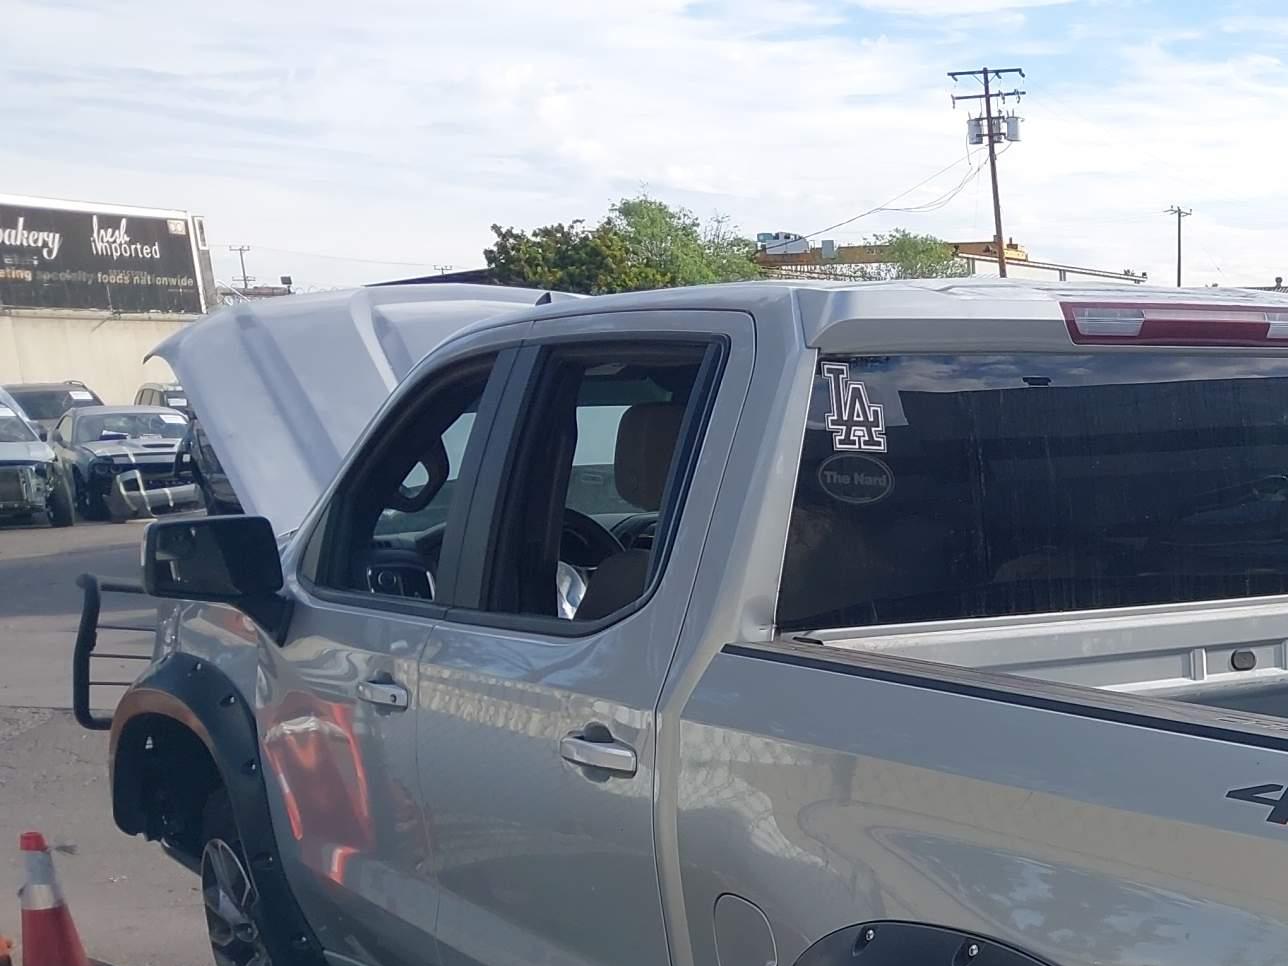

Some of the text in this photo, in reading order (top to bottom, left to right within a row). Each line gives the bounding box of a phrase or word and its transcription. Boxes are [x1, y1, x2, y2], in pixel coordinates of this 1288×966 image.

[92, 214, 130, 252] fresh
[90, 237, 160, 260] imported
[98, 271, 130, 284] foods
[821, 361, 887, 453] LA
[823, 470, 887, 487] The Nard
